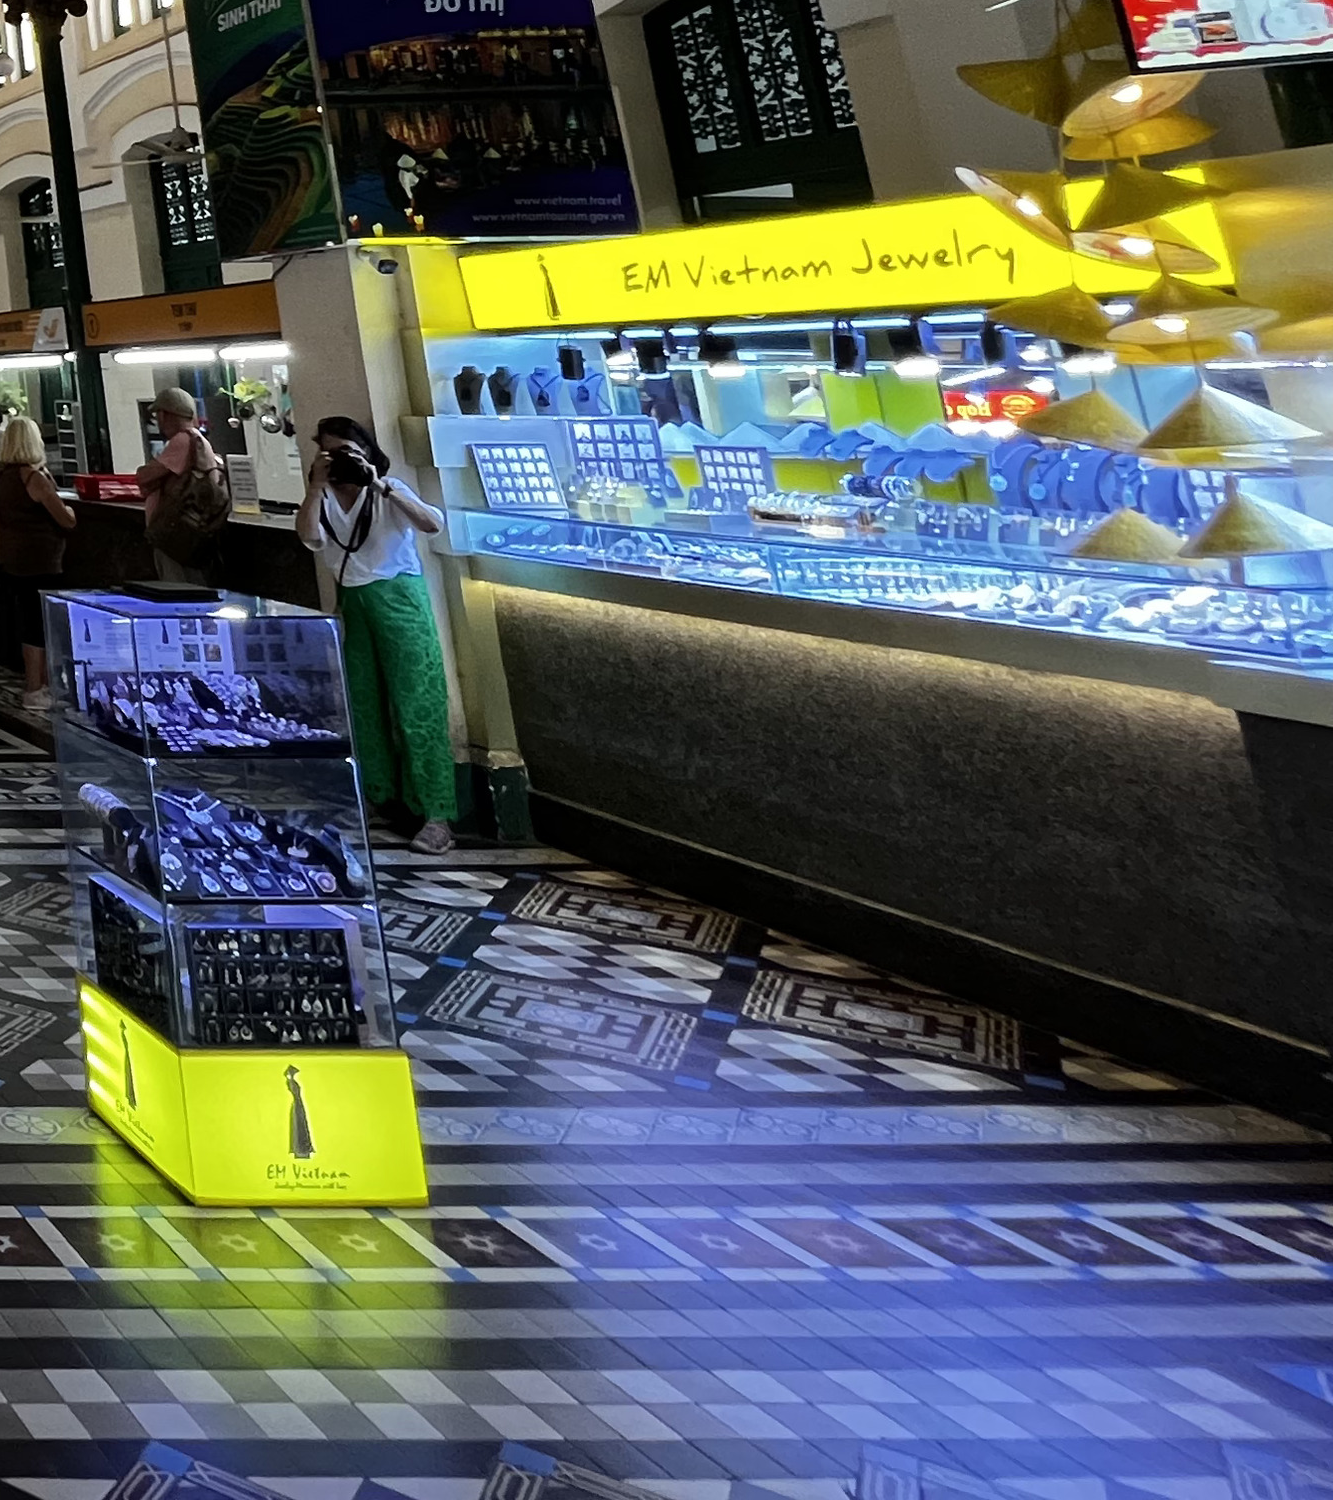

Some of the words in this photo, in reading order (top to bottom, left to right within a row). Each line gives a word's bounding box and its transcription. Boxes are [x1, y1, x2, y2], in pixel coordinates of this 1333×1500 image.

[217, 4, 248, 32] SINH
[514, 194, 621, 205] www.vietnam.travel
[472, 212, 624, 224] www.vietnamtourism.gov.vn
[621, 261, 671, 293] EM
[683, 254, 832, 288] Vietnam
[851, 229, 1014, 285] Jewelry
[267, 1164, 286, 1179] EM
[292, 1163, 351, 1179] Vietnam
